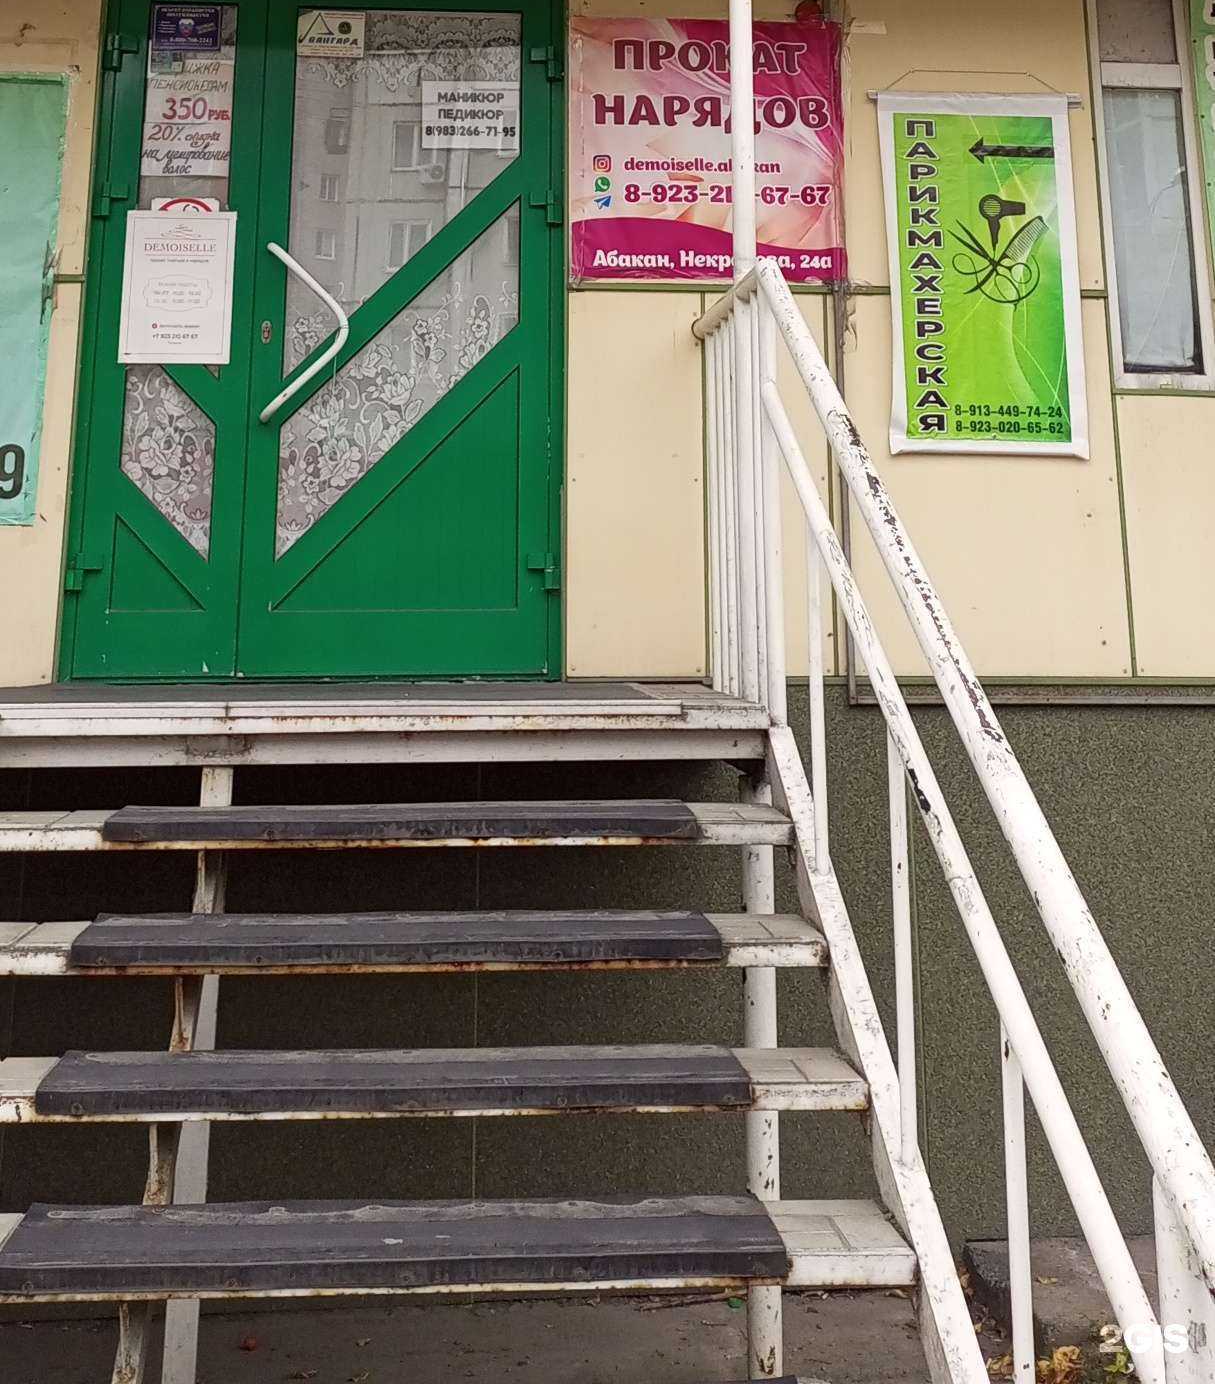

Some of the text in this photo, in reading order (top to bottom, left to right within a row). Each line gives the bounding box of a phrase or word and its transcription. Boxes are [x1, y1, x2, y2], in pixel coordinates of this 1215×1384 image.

[437, 92, 505, 104] МАНИКЮР
[162, 96, 208, 120] 350
[437, 108, 505, 122] ПЕДИКЮР
[623, 183, 832, 206] 8-923-21-67-67
[144, 242, 217, 252] DEMOISELLE
[592, 249, 675, 269] Абакан,
[799, 254, 832, 269] 24а
[904, 118, 952, 434] ПАРИКМАХЕРСКАЯ
[954, 403, 1063, 418] 8-913-449-74-24
[955, 419, 1064, 434] 8-923-020-65-62
